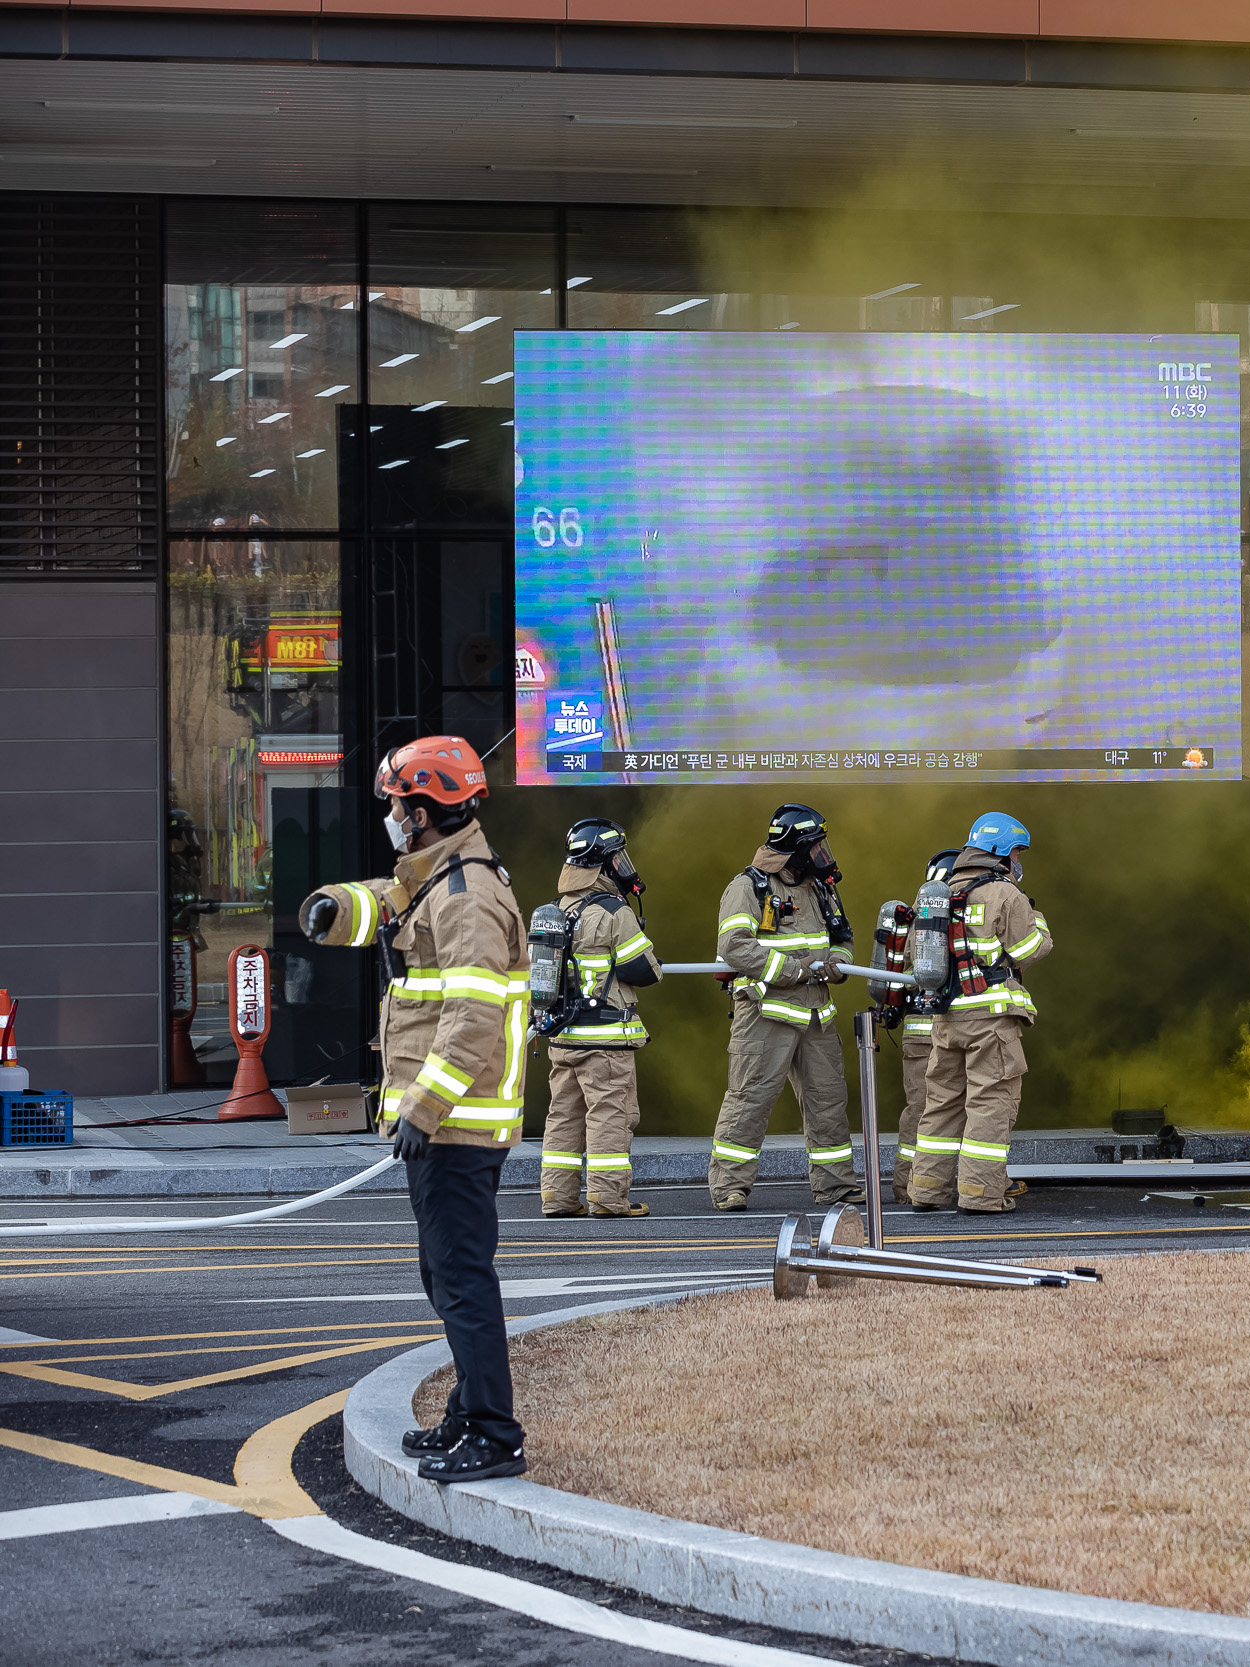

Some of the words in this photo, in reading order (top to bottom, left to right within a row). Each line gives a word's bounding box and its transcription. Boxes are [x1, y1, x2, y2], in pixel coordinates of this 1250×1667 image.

[1159, 362, 1212, 382] MBC
[1170, 403, 1207, 418] 6:39
[532, 507, 584, 547] 66
[561, 701, 589, 717] 뉴스
[554, 718, 596, 734] 투데이
[562, 754, 587, 770] 국제
[641, 754, 679, 770] 가디언
[681, 754, 712, 770] "푸틴
[715, 754, 729, 769] 군
[732, 753, 758, 769] 내부
[761, 753, 799, 769] 비판과
[801, 753, 839, 769] 자존심
[842, 753, 880, 769] 상처에
[883, 753, 922, 769] 우크라
[924, 753, 950, 768] 공습
[953, 752, 983, 768] 감행"
[1105, 750, 1130, 765] 대구
[242, 960, 259, 1027] 주차금지
